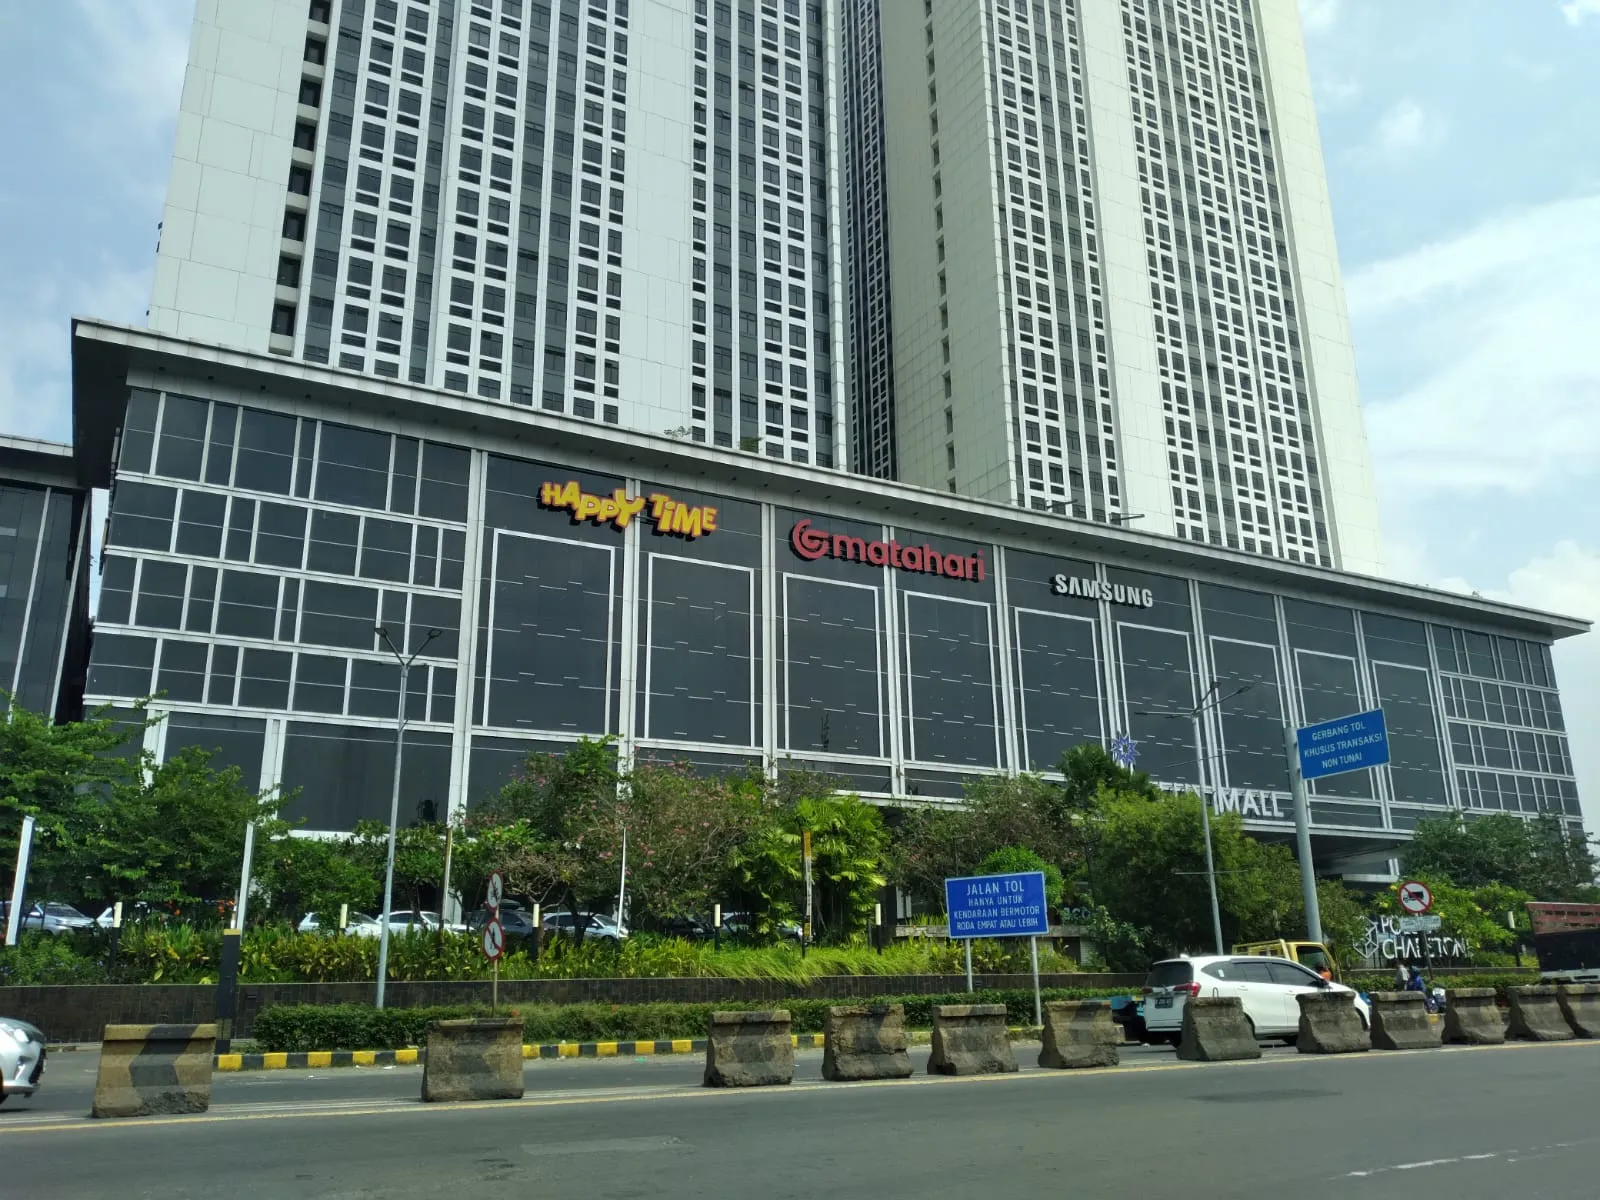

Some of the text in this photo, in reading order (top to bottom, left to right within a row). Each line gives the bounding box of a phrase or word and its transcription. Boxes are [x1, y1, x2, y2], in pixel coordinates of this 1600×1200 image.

[541, 480, 645, 528] HAPPY
[833, 534, 984, 580] matahari
[1055, 573, 1153, 607] SAMSUNG
[1312, 721, 1366, 741] GERBANG TOL
[1304, 732, 1382, 758] KHUSUS TRANSAKSI
[1322, 752, 1362, 768] NON TUNAI
[1218, 788, 1284, 817] MALL
[967, 880, 1024, 896] JALAN TOL
[969, 895, 1022, 907] HANYA UNTUK
[954, 906, 1039, 919] KENDARAAN BERMOTOR
[957, 918, 1037, 930] RODA EMPAT ATAU LEBIH
